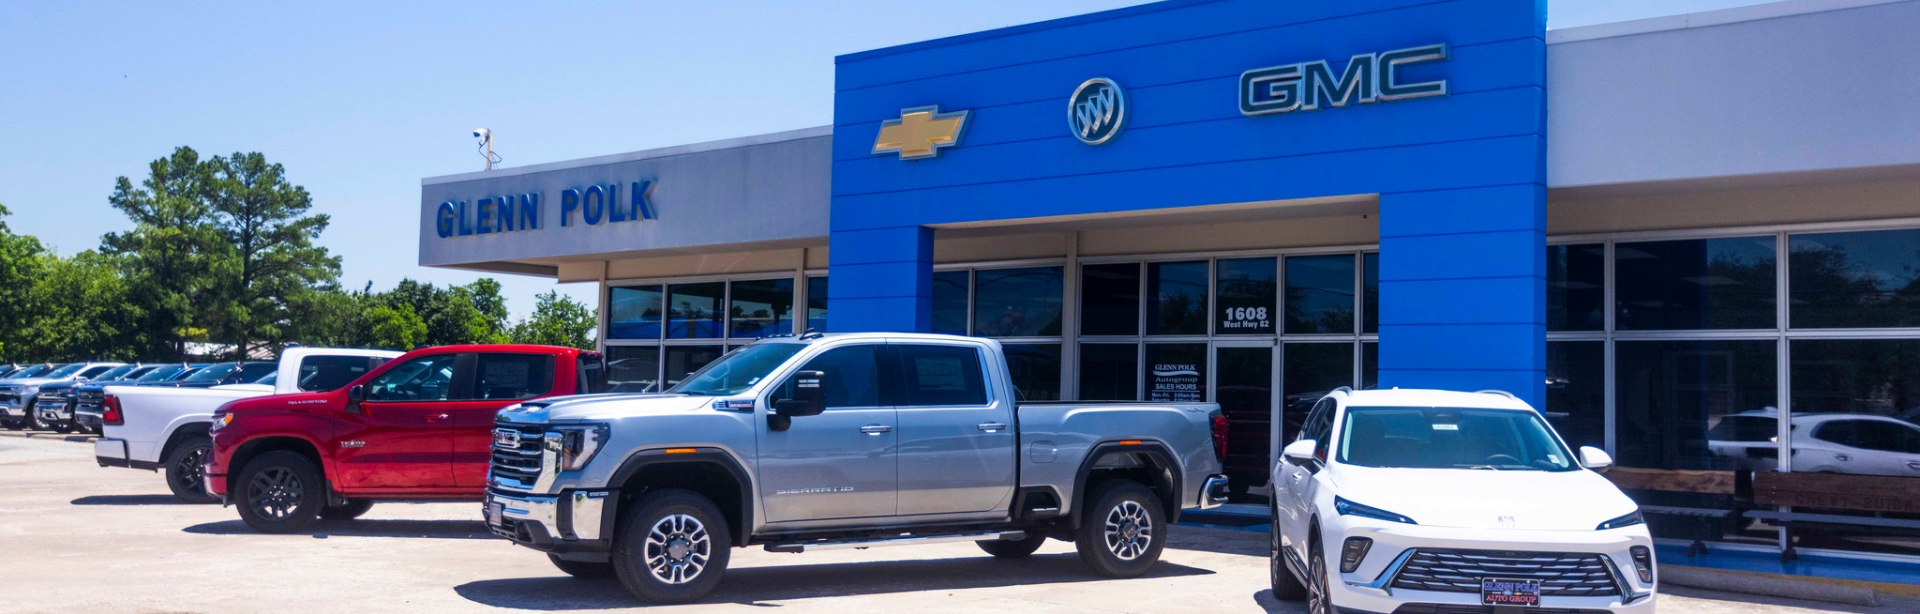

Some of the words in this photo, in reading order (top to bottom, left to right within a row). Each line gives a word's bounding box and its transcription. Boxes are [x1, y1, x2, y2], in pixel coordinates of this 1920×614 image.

[1239, 42, 1448, 117] GMC
[436, 192, 541, 238] GLENN
[561, 179, 657, 227] POLK
[1225, 306, 1267, 320] 1608
[1223, 320, 1241, 328] West
[1242, 320, 1258, 329] Hwy
[1259, 320, 1269, 328] 82
[1155, 376, 1198, 384] Autogroup
[1484, 581, 1513, 591] GLENN
[1514, 582, 1539, 592] POLK
[1486, 594, 1508, 602] AUTO
[1508, 595, 1537, 603] GROUP
